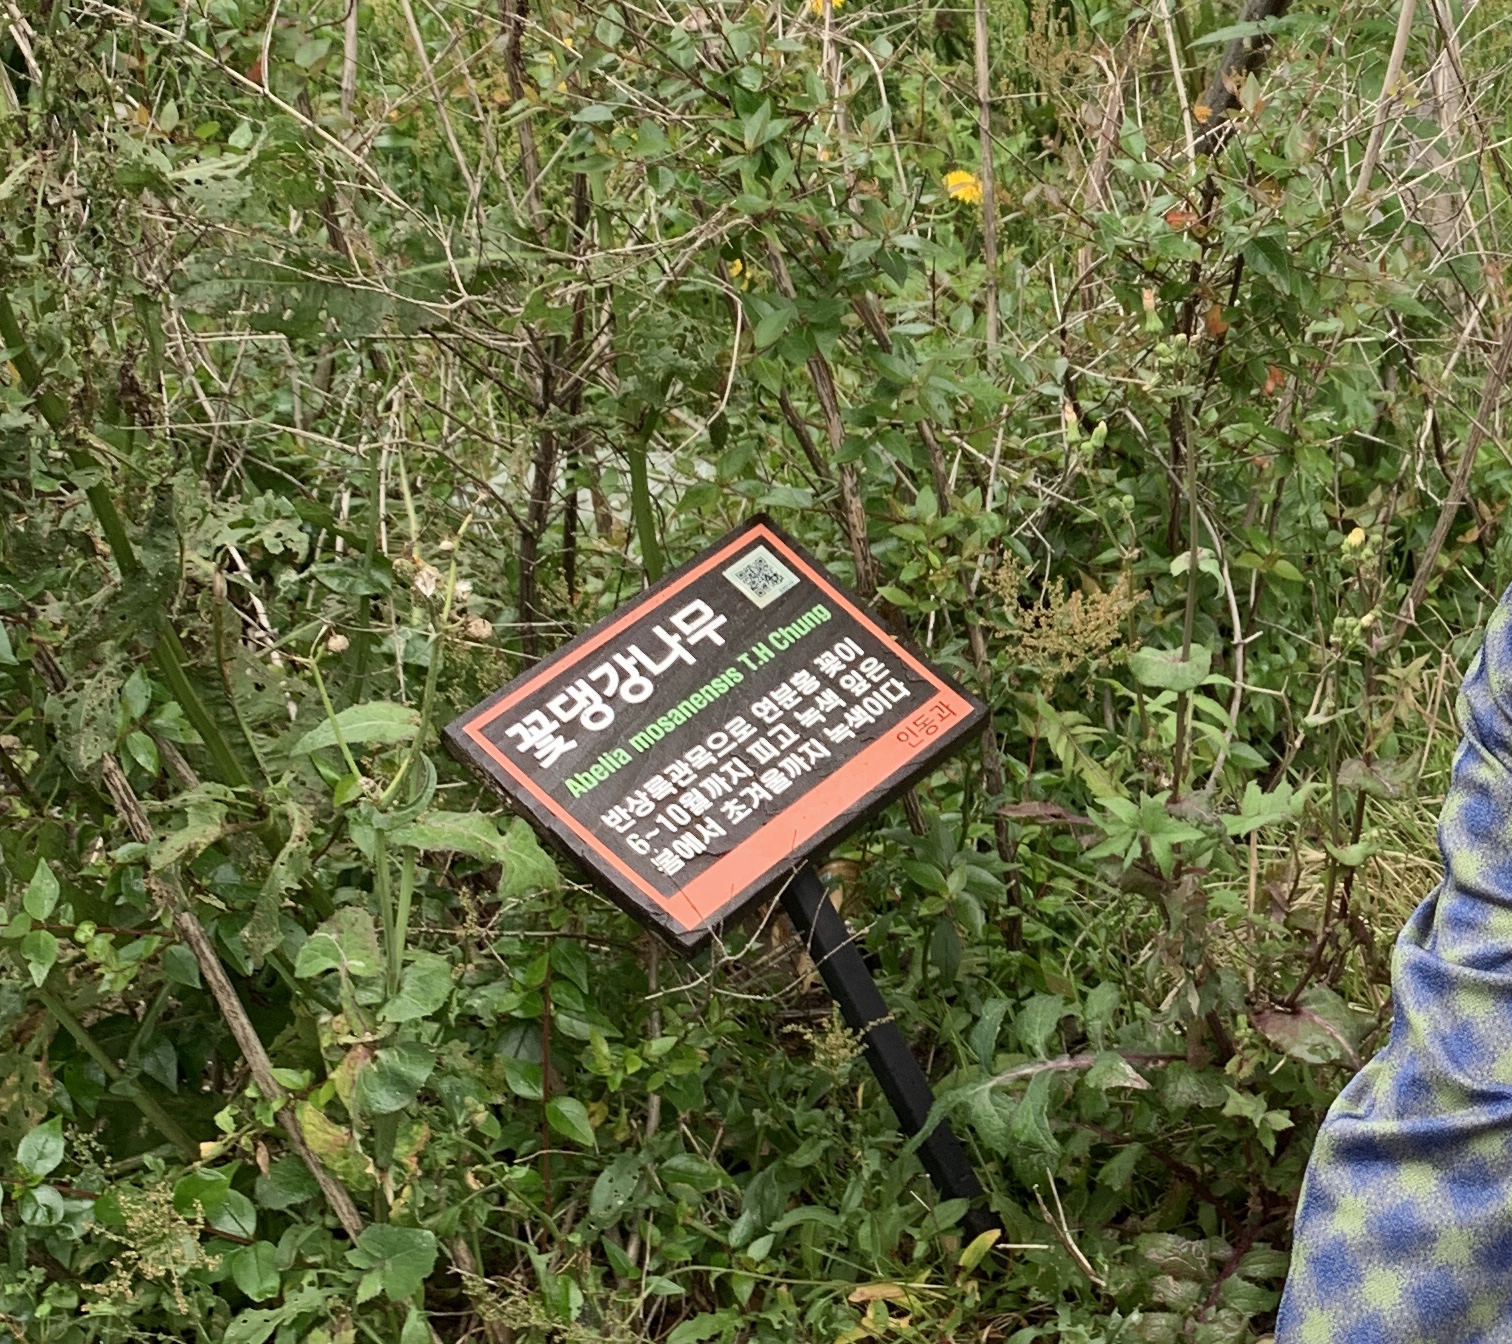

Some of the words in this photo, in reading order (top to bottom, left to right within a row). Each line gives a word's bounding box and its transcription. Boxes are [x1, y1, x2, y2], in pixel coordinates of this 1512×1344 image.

[505, 598, 728, 769] 꽃댕강나무
[563, 746, 633, 799] Abelia
[628, 666, 745, 754] mosanensis
[736, 641, 776, 672] T.H
[768, 603, 833, 652] Chung
[600, 715, 758, 834] 반상록관목으로
[750, 668, 822, 724] 연분홍
[813, 636, 865, 679] 꽃이
[625, 757, 755, 856] 6~10월까지
[745, 722, 801, 765] 피고
[793, 687, 847, 729] 녹색
[838, 656, 891, 698] 잎은
[719, 737, 832, 827] 초겨울까지
[822, 677, 912, 744] 녹색이다
[896, 700, 958, 749] 인동과
